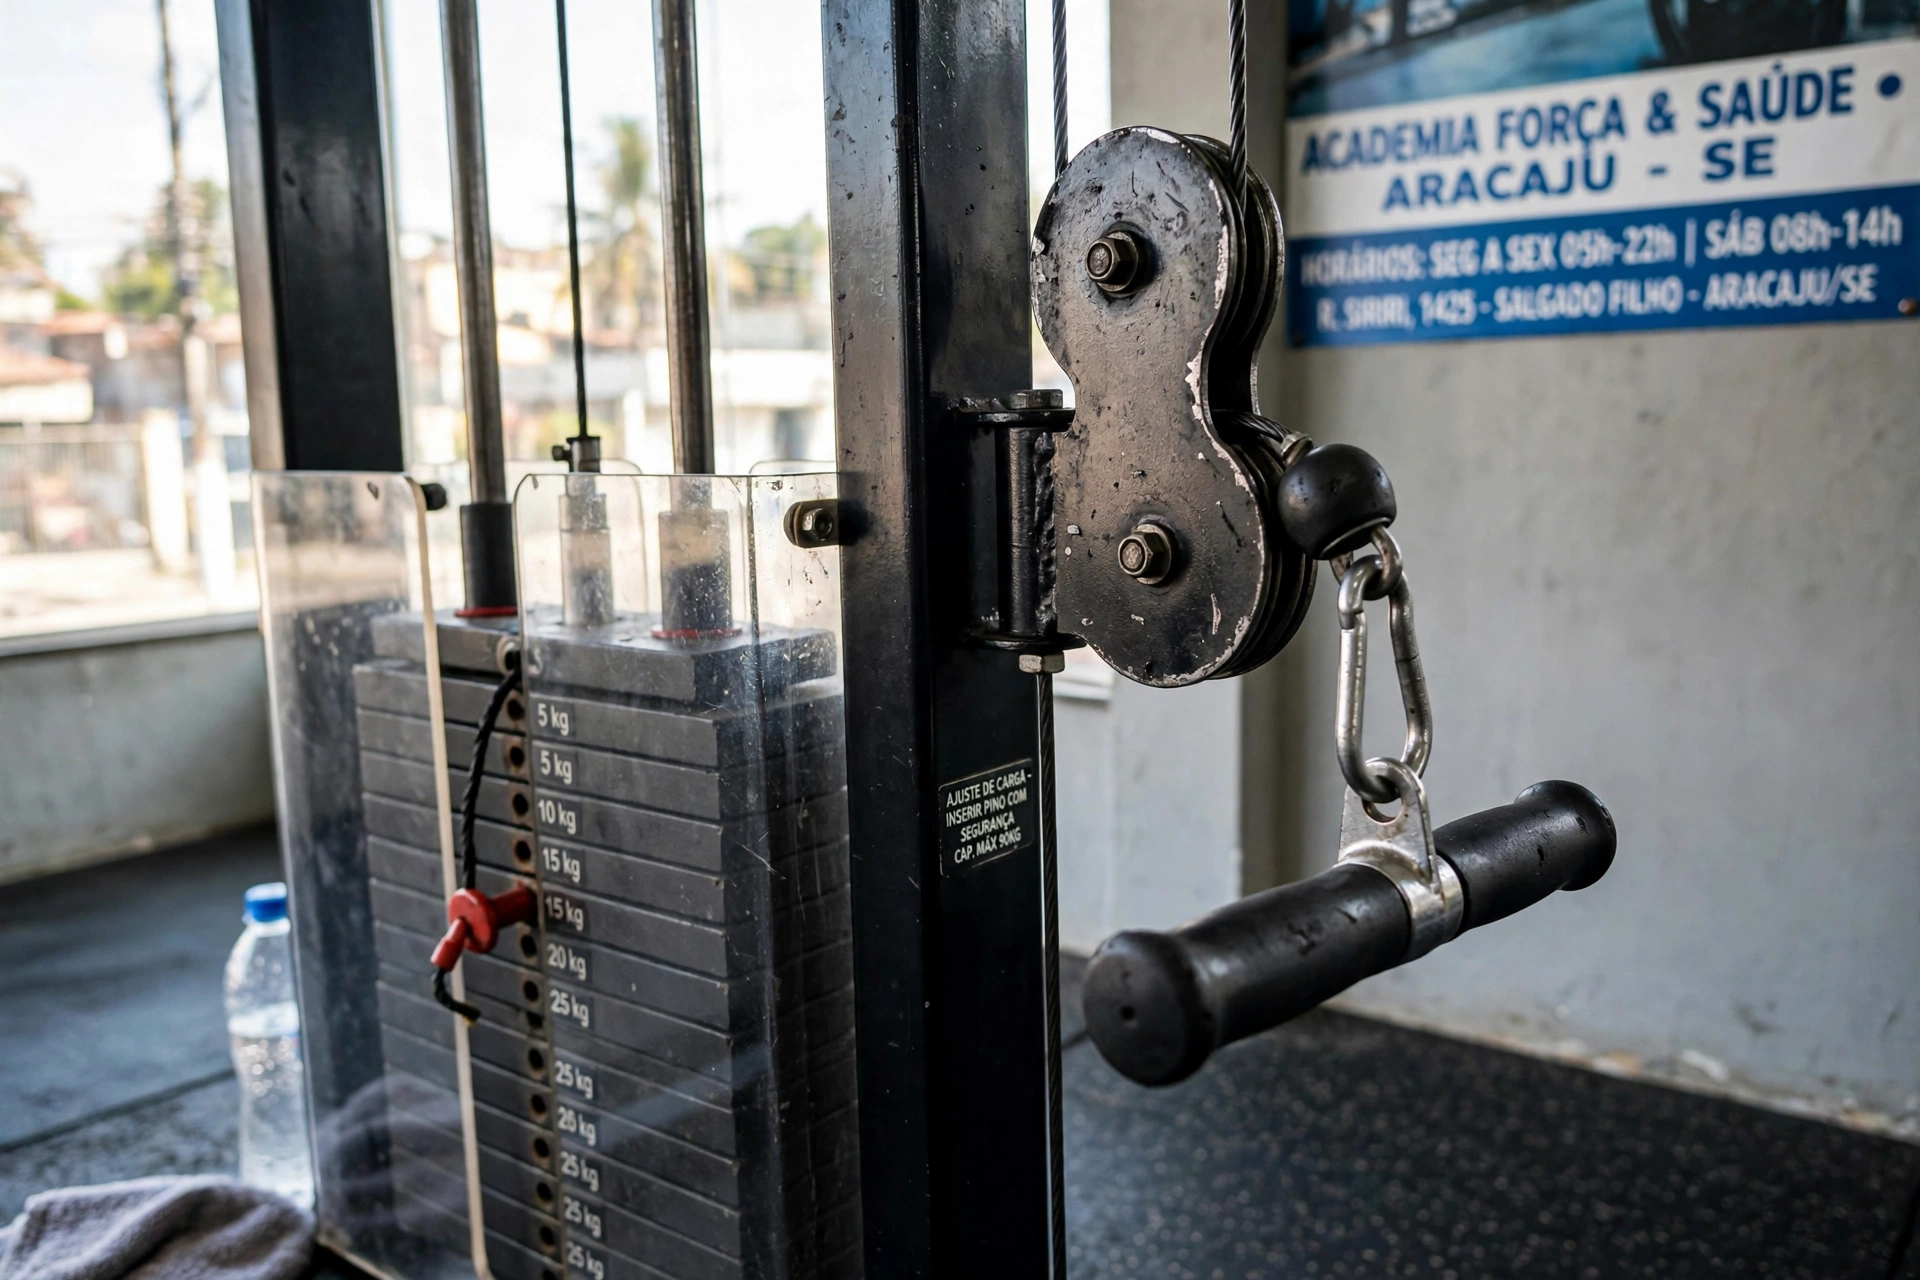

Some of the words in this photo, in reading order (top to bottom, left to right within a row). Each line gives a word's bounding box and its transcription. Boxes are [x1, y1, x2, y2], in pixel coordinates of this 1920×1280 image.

[1301, 114, 1480, 175] ACADEMIA
[1497, 94, 1626, 152] FORÇA
[1647, 91, 1676, 136] &
[1698, 62, 1856, 129] SAÚDE
[1382, 152, 1617, 212] ARACAJU
[1703, 137, 1776, 182] SE
[1301, 240, 1427, 287] HORÁRIOS:
[1429, 237, 1480, 279] SEG
[1482, 236, 1504, 275] A
[1505, 233, 1558, 274] SEX
[1560, 223, 1677, 269] 05h-22h
[1704, 209, 1766, 259] SÁB
[1770, 205, 1903, 252] 08h-14h
[1493, 280, 1606, 323] SALGADO
[1608, 275, 1684, 317] FILHO
[1703, 263, 1879, 312] ARACAJU/SE
[538, 703, 548, 727] 5
[551, 705, 569, 736] kg
[540, 751, 551, 775] 5
[554, 752, 572, 785] kg
[946, 784, 980, 808] AJUSTE
[982, 779, 995, 796] DE
[997, 769, 1026, 790] CARGA
[946, 805, 982, 828] INSERIR
[984, 795, 1006, 814] PINO
[1007, 787, 1028, 806] COM
[538, 799, 555, 825] 10
[558, 803, 576, 835] kg
[960, 811, 1015, 843] SEGURANÇA
[543, 847, 560, 872] 15
[563, 850, 581, 883] kg
[954, 844, 975, 864] CAP.
[976, 834, 997, 856] MÁX
[545, 895, 563, 920] 15
[565, 899, 584, 932] kg
[547, 944, 566, 970] 20
[568, 947, 586, 980] kg
[550, 989, 570, 1016] 25
[571, 994, 589, 1028] kg
[555, 1060, 574, 1087] 25
[576, 1066, 593, 1100] kg
[578, 1112, 596, 1147] kg
[561, 1152, 580, 1178] 25
[581, 1157, 599, 1192] kg
[564, 1197, 583, 1223] 25
[584, 1203, 602, 1238] kg
[567, 1242, 586, 1268] 25
[586, 1247, 604, 1280] kg
